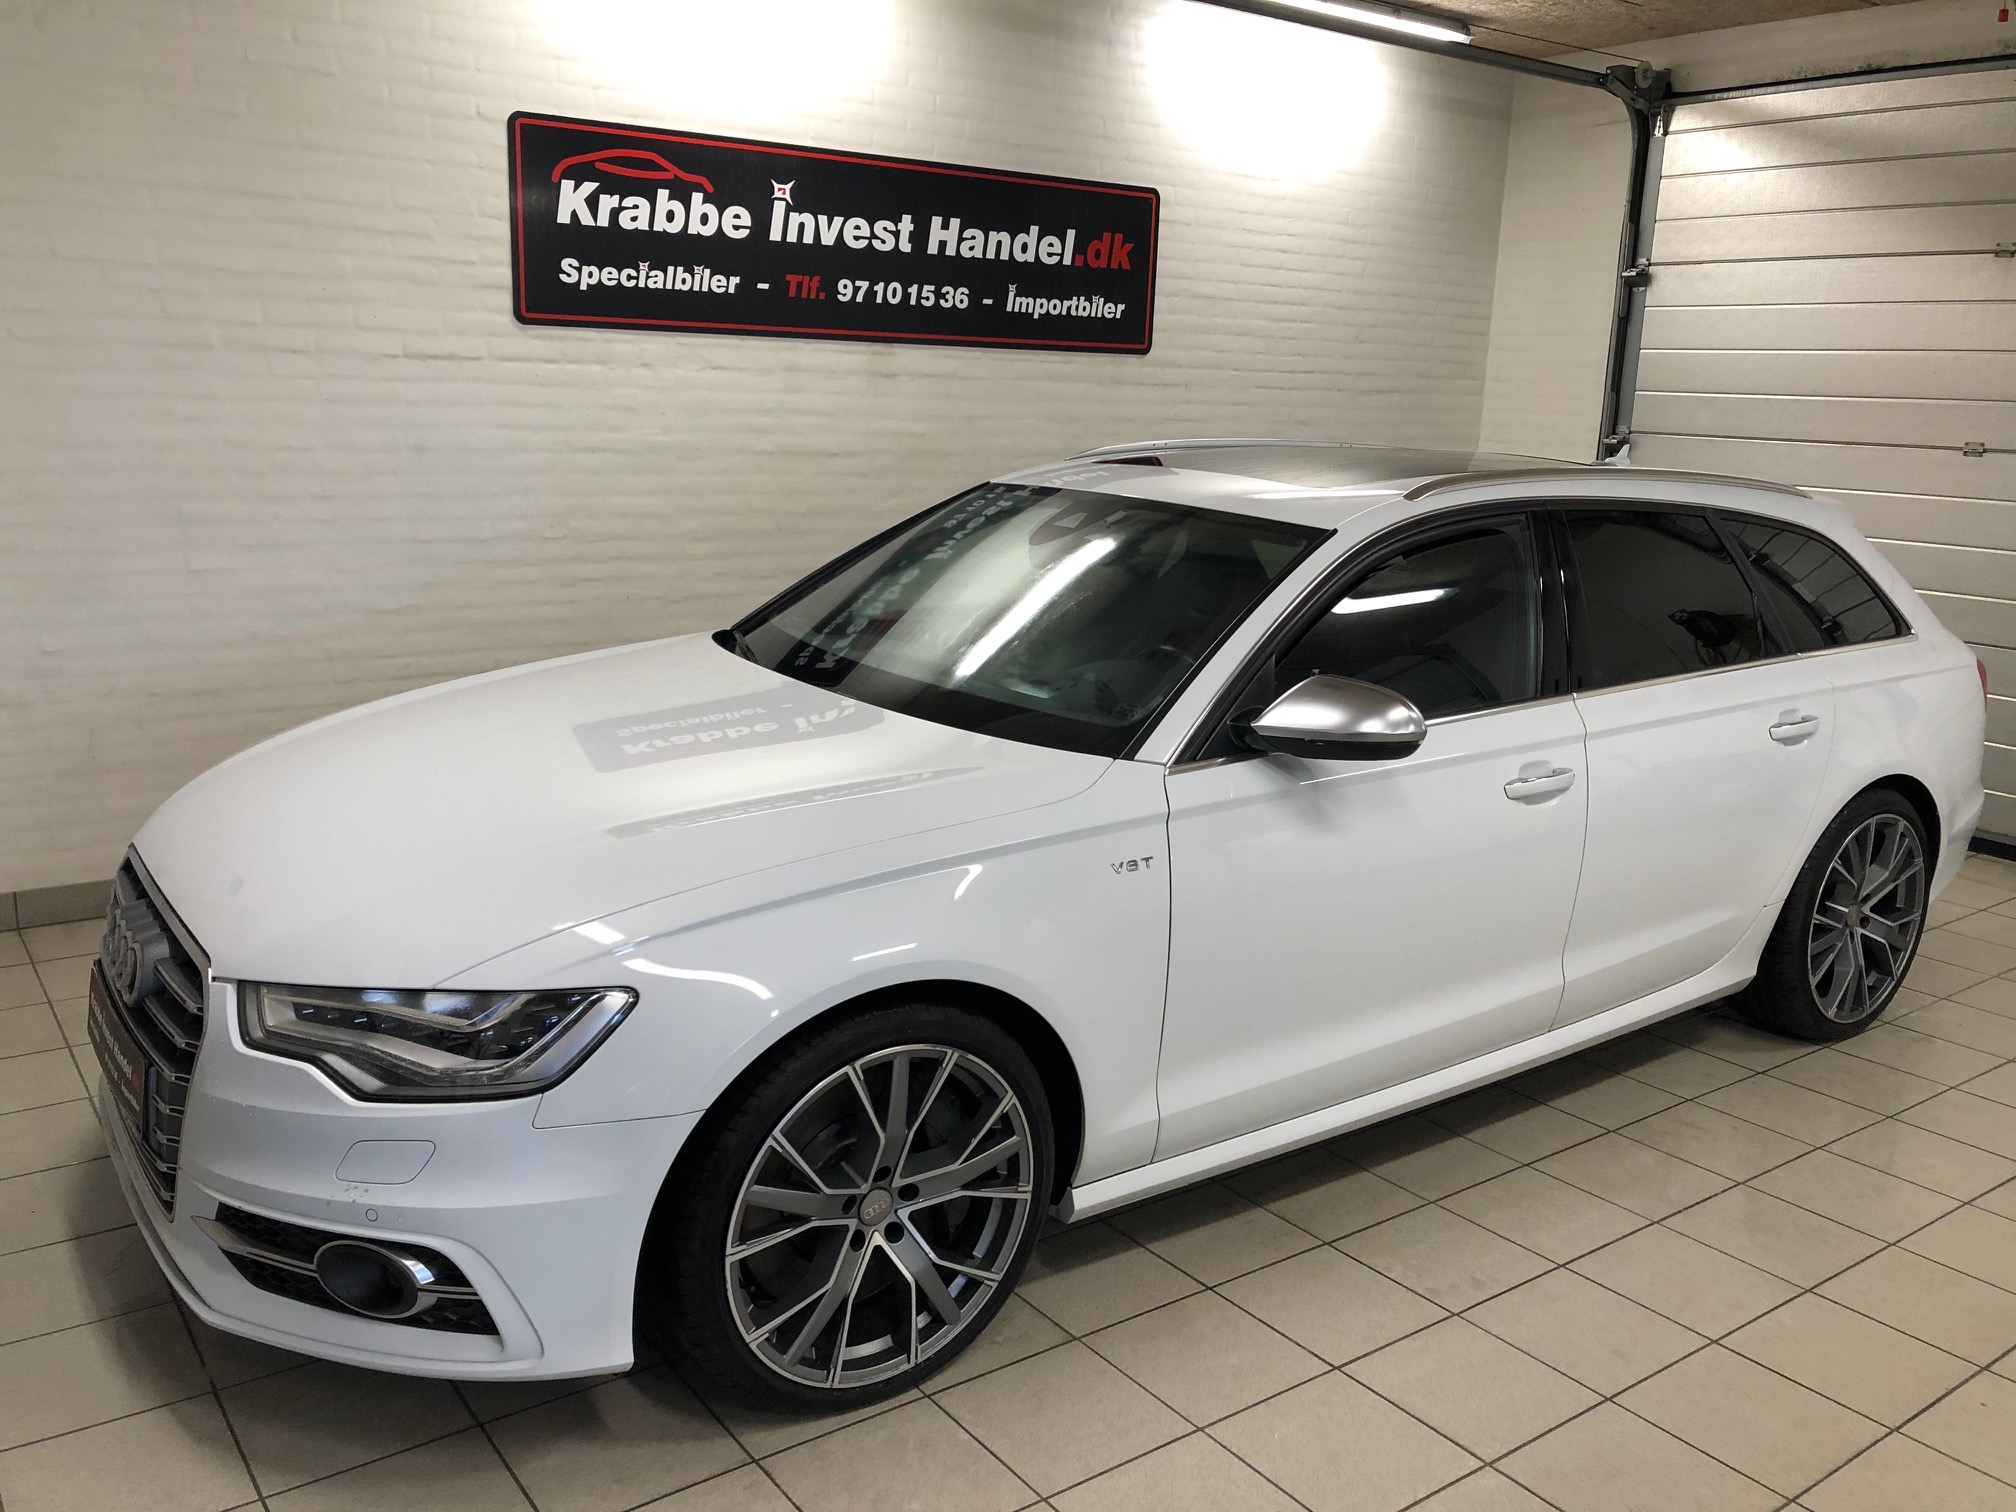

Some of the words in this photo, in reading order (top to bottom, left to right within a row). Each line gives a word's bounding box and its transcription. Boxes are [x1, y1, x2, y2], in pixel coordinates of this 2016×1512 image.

[556, 179, 751, 240] Krabbe
[768, 180, 915, 253] Invest
[927, 215, 1135, 270] Handel.dk
[558, 257, 740, 294] Specialbiler
[785, 274, 826, 300] Tlf.
[1005, 285, 1126, 319] Importbiler
